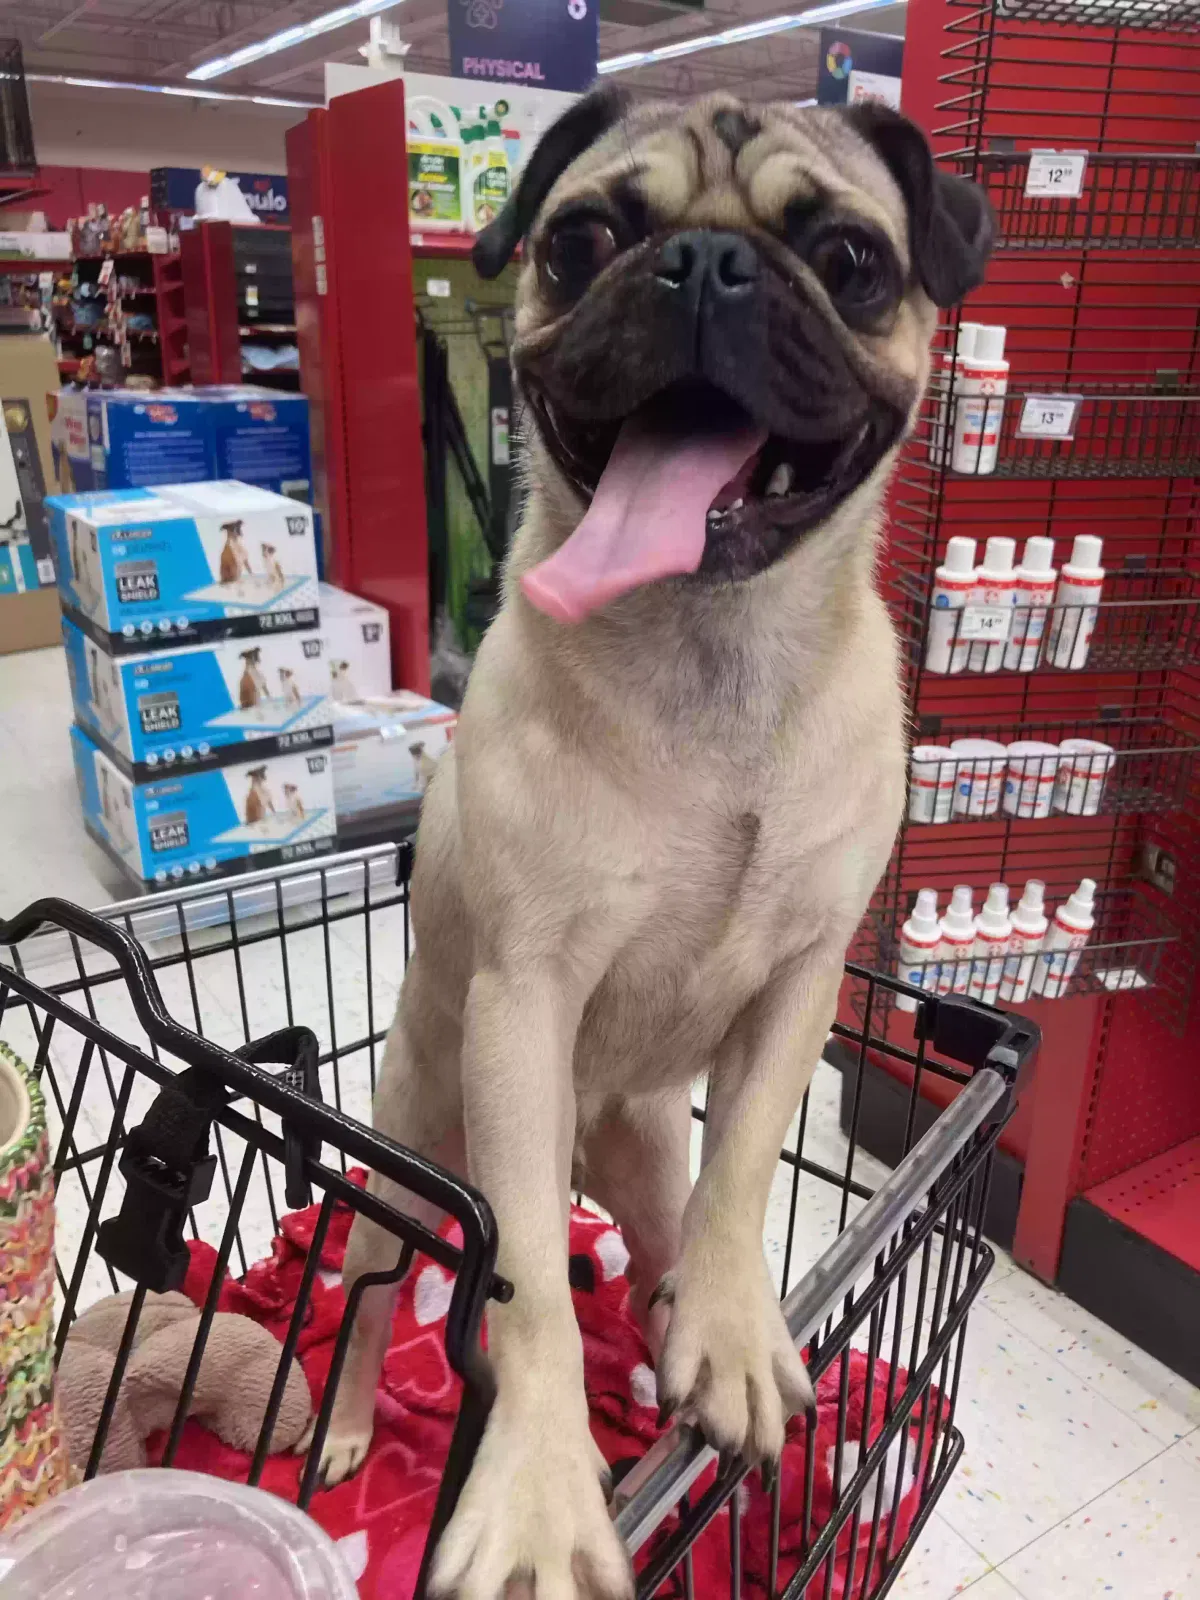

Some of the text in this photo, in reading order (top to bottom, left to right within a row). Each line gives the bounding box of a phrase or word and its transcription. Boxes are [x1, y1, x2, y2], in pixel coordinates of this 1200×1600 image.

[462, 57, 545, 80] PHYSICAL
[120, 574, 156, 591] LEAK
[142, 707, 178, 721] LEAK
[152, 825, 186, 840] LEAK
